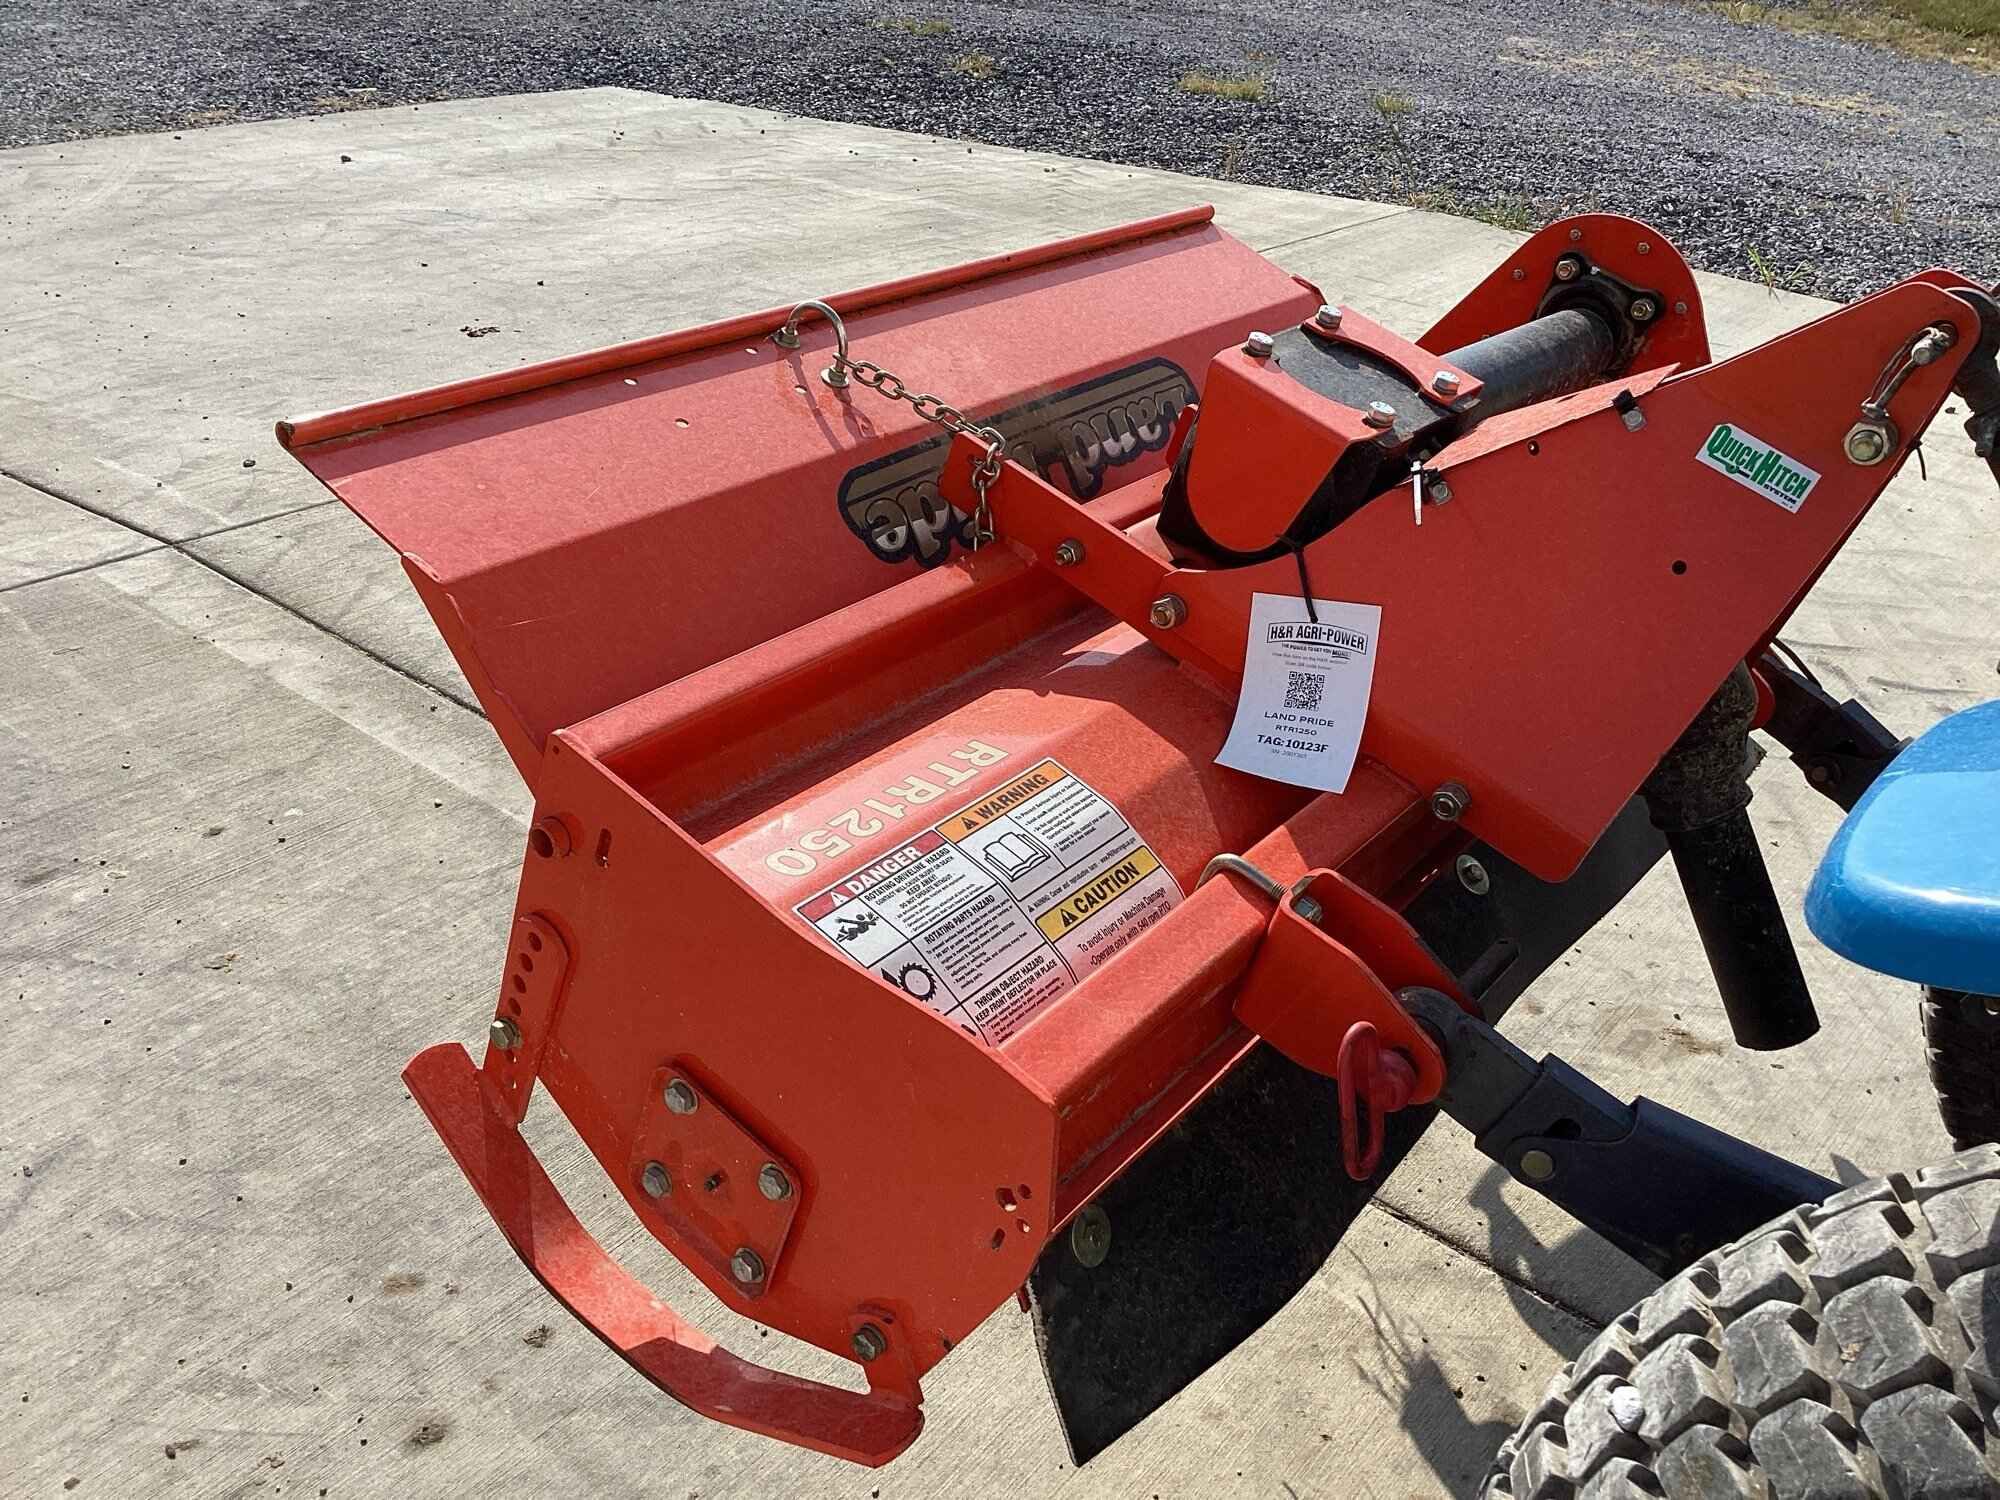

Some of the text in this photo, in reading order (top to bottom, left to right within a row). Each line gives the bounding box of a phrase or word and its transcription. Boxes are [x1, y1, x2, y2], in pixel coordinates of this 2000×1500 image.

[1763, 484, 1797, 504] SYSTEM
[1270, 625, 1365, 651] H&R AGRI-POWER
[1264, 711, 1335, 727] LAND PRIDE
[1275, 724, 1318, 736] RTR1250
[765, 740, 1009, 876] RTR1250
[976, 774, 1049, 820] WARNING
[846, 847, 923, 894] DANGER
[864, 881, 895, 902] ROTATING
[894, 863, 925, 883] DRIVELINE
[926, 848, 950, 864] HAZARD
[907, 875, 937, 895] KEEP AWAY!
[1073, 863, 1140, 915] CAUTION
[925, 921, 955, 944] ROTATING
[953, 909, 973, 925] PARTS
[971, 895, 996, 913] HAZARD
[1078, 887, 1166, 953] To avoid Injury or Machine Damage
[1112, 934, 1127, 949] only
[1125, 926, 1139, 939] with
[1137, 918, 1150, 931] 540
[1146, 910, 1160, 924] rpm
[1157, 902, 1172, 916] PTO
[974, 956, 1045, 1009] THROWN OBJECT HAZARD
[975, 959, 1057, 1022] KEEP FRONT DEFLECTOR IN PLACE
